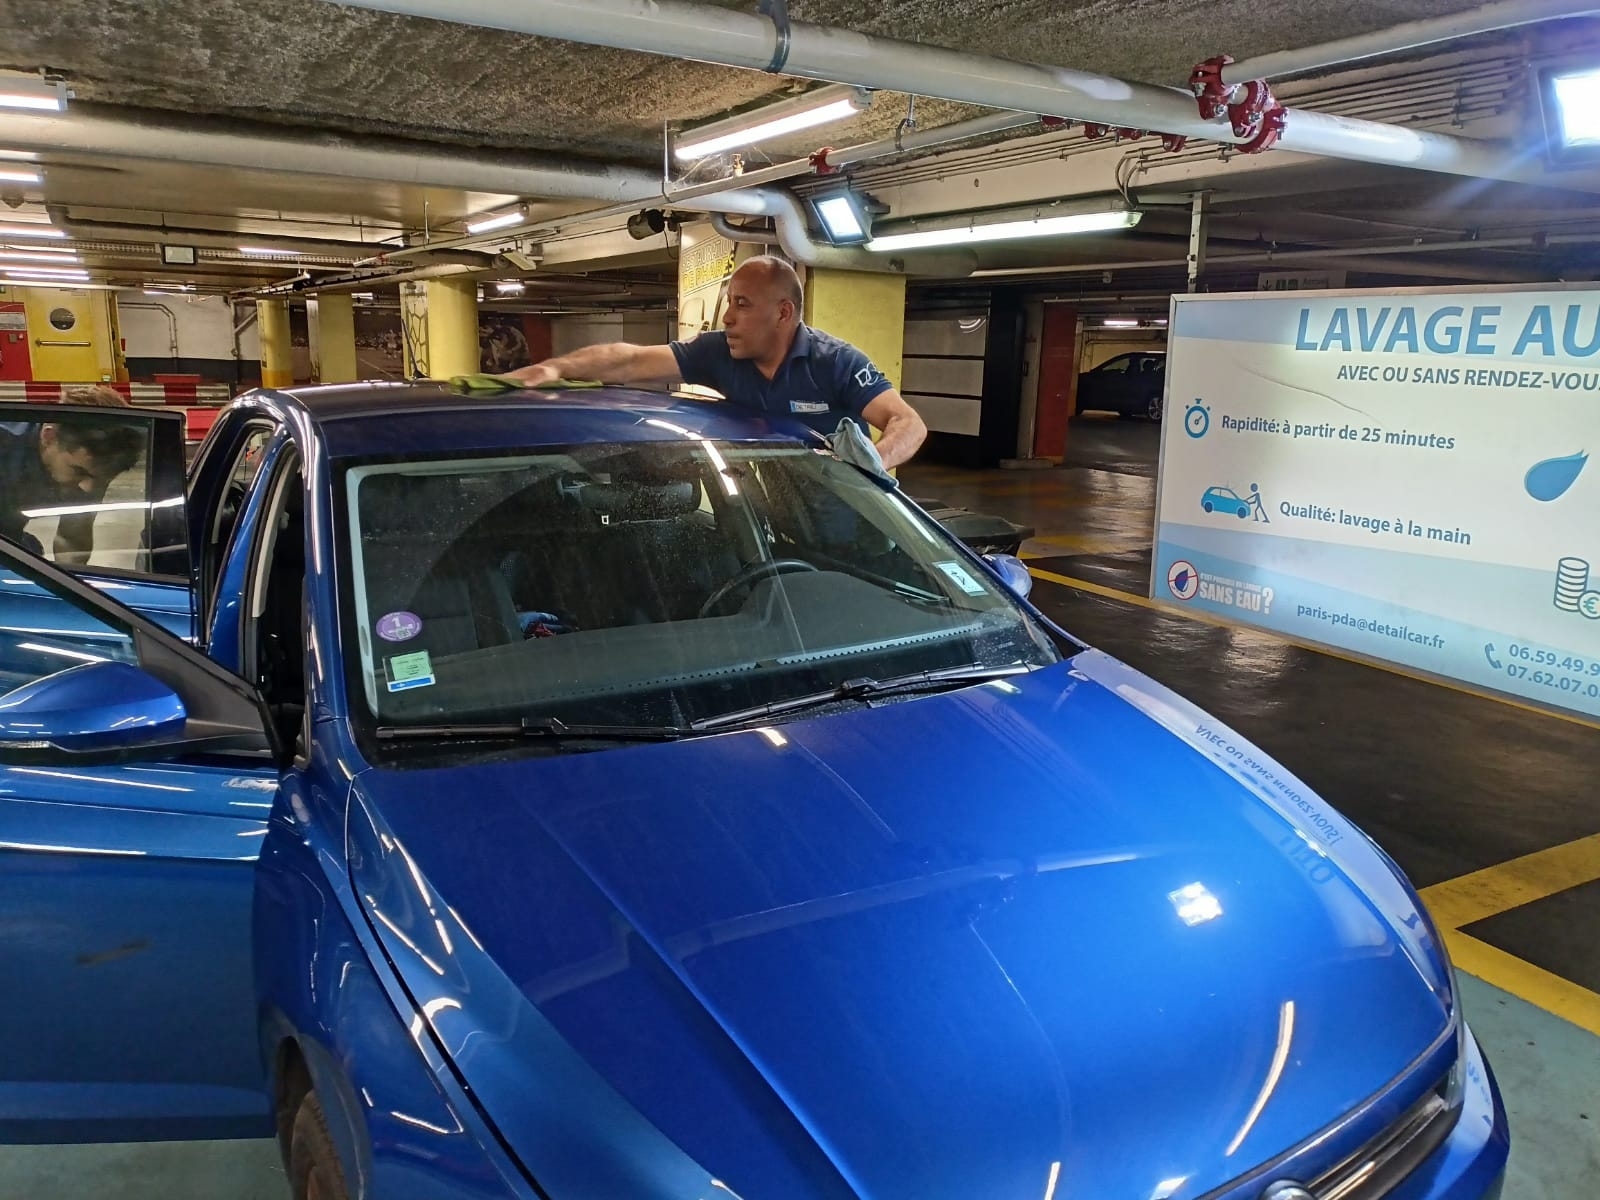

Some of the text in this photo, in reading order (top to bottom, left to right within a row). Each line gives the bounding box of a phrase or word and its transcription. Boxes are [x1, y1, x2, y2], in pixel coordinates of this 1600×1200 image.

[1296, 305, 1501, 355] LAVAGE
[1337, 365, 1600, 391] AVEC OU SANS RENDEZ-VOU
[1222, 415, 1456, 450] Rapidité: à partir de 25 minutes
[1280, 501, 1472, 545] Qualité: lavage à la main
[1199, 581, 1233, 605] SANS
[1297, 604, 1445, 649] paris-pda@detailcar.fr
[1507, 663, 1600, 698] 07.62.07.0
